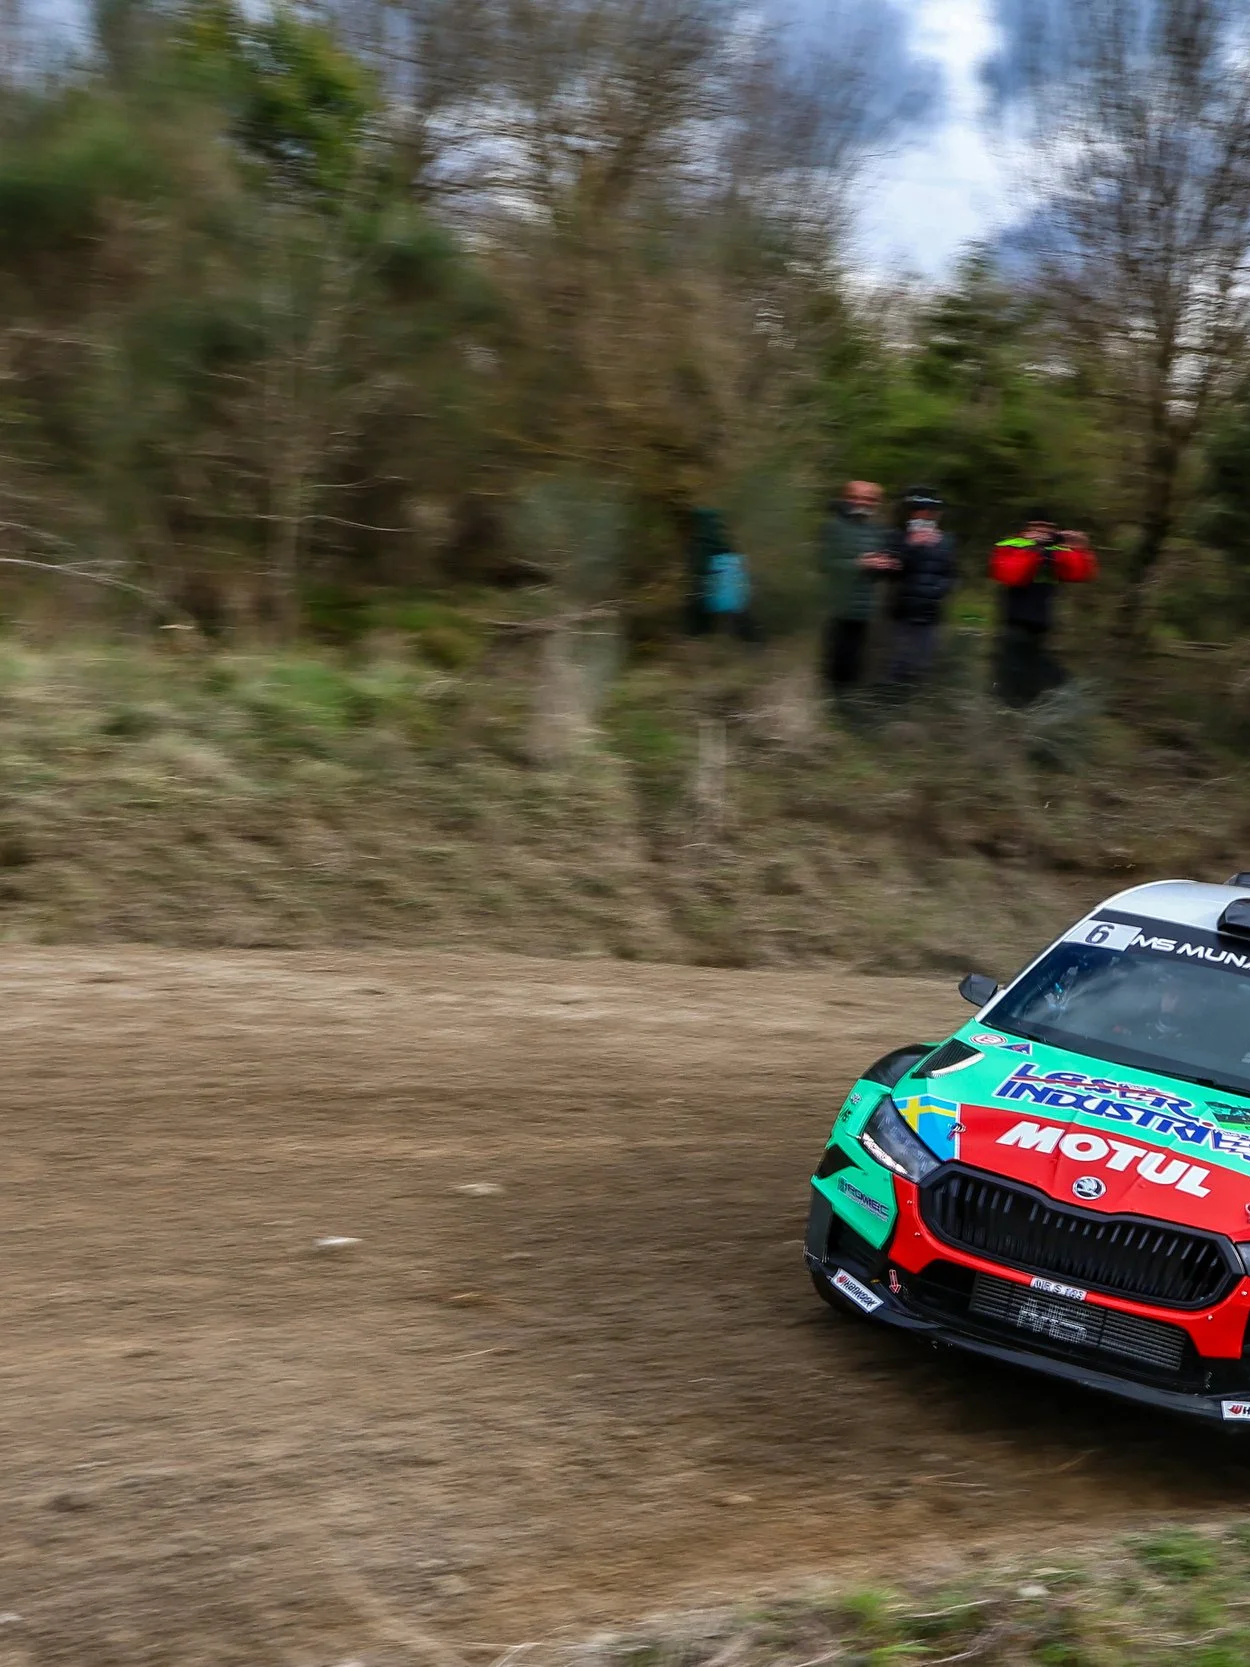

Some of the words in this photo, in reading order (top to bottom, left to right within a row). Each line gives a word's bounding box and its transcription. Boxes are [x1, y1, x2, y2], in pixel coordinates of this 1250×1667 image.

[1085, 924, 1115, 944] 6
[1129, 934, 1177, 952] MS
[995, 1120, 1212, 1198] MOTUL
[844, 1183, 889, 1217] FOMEC
